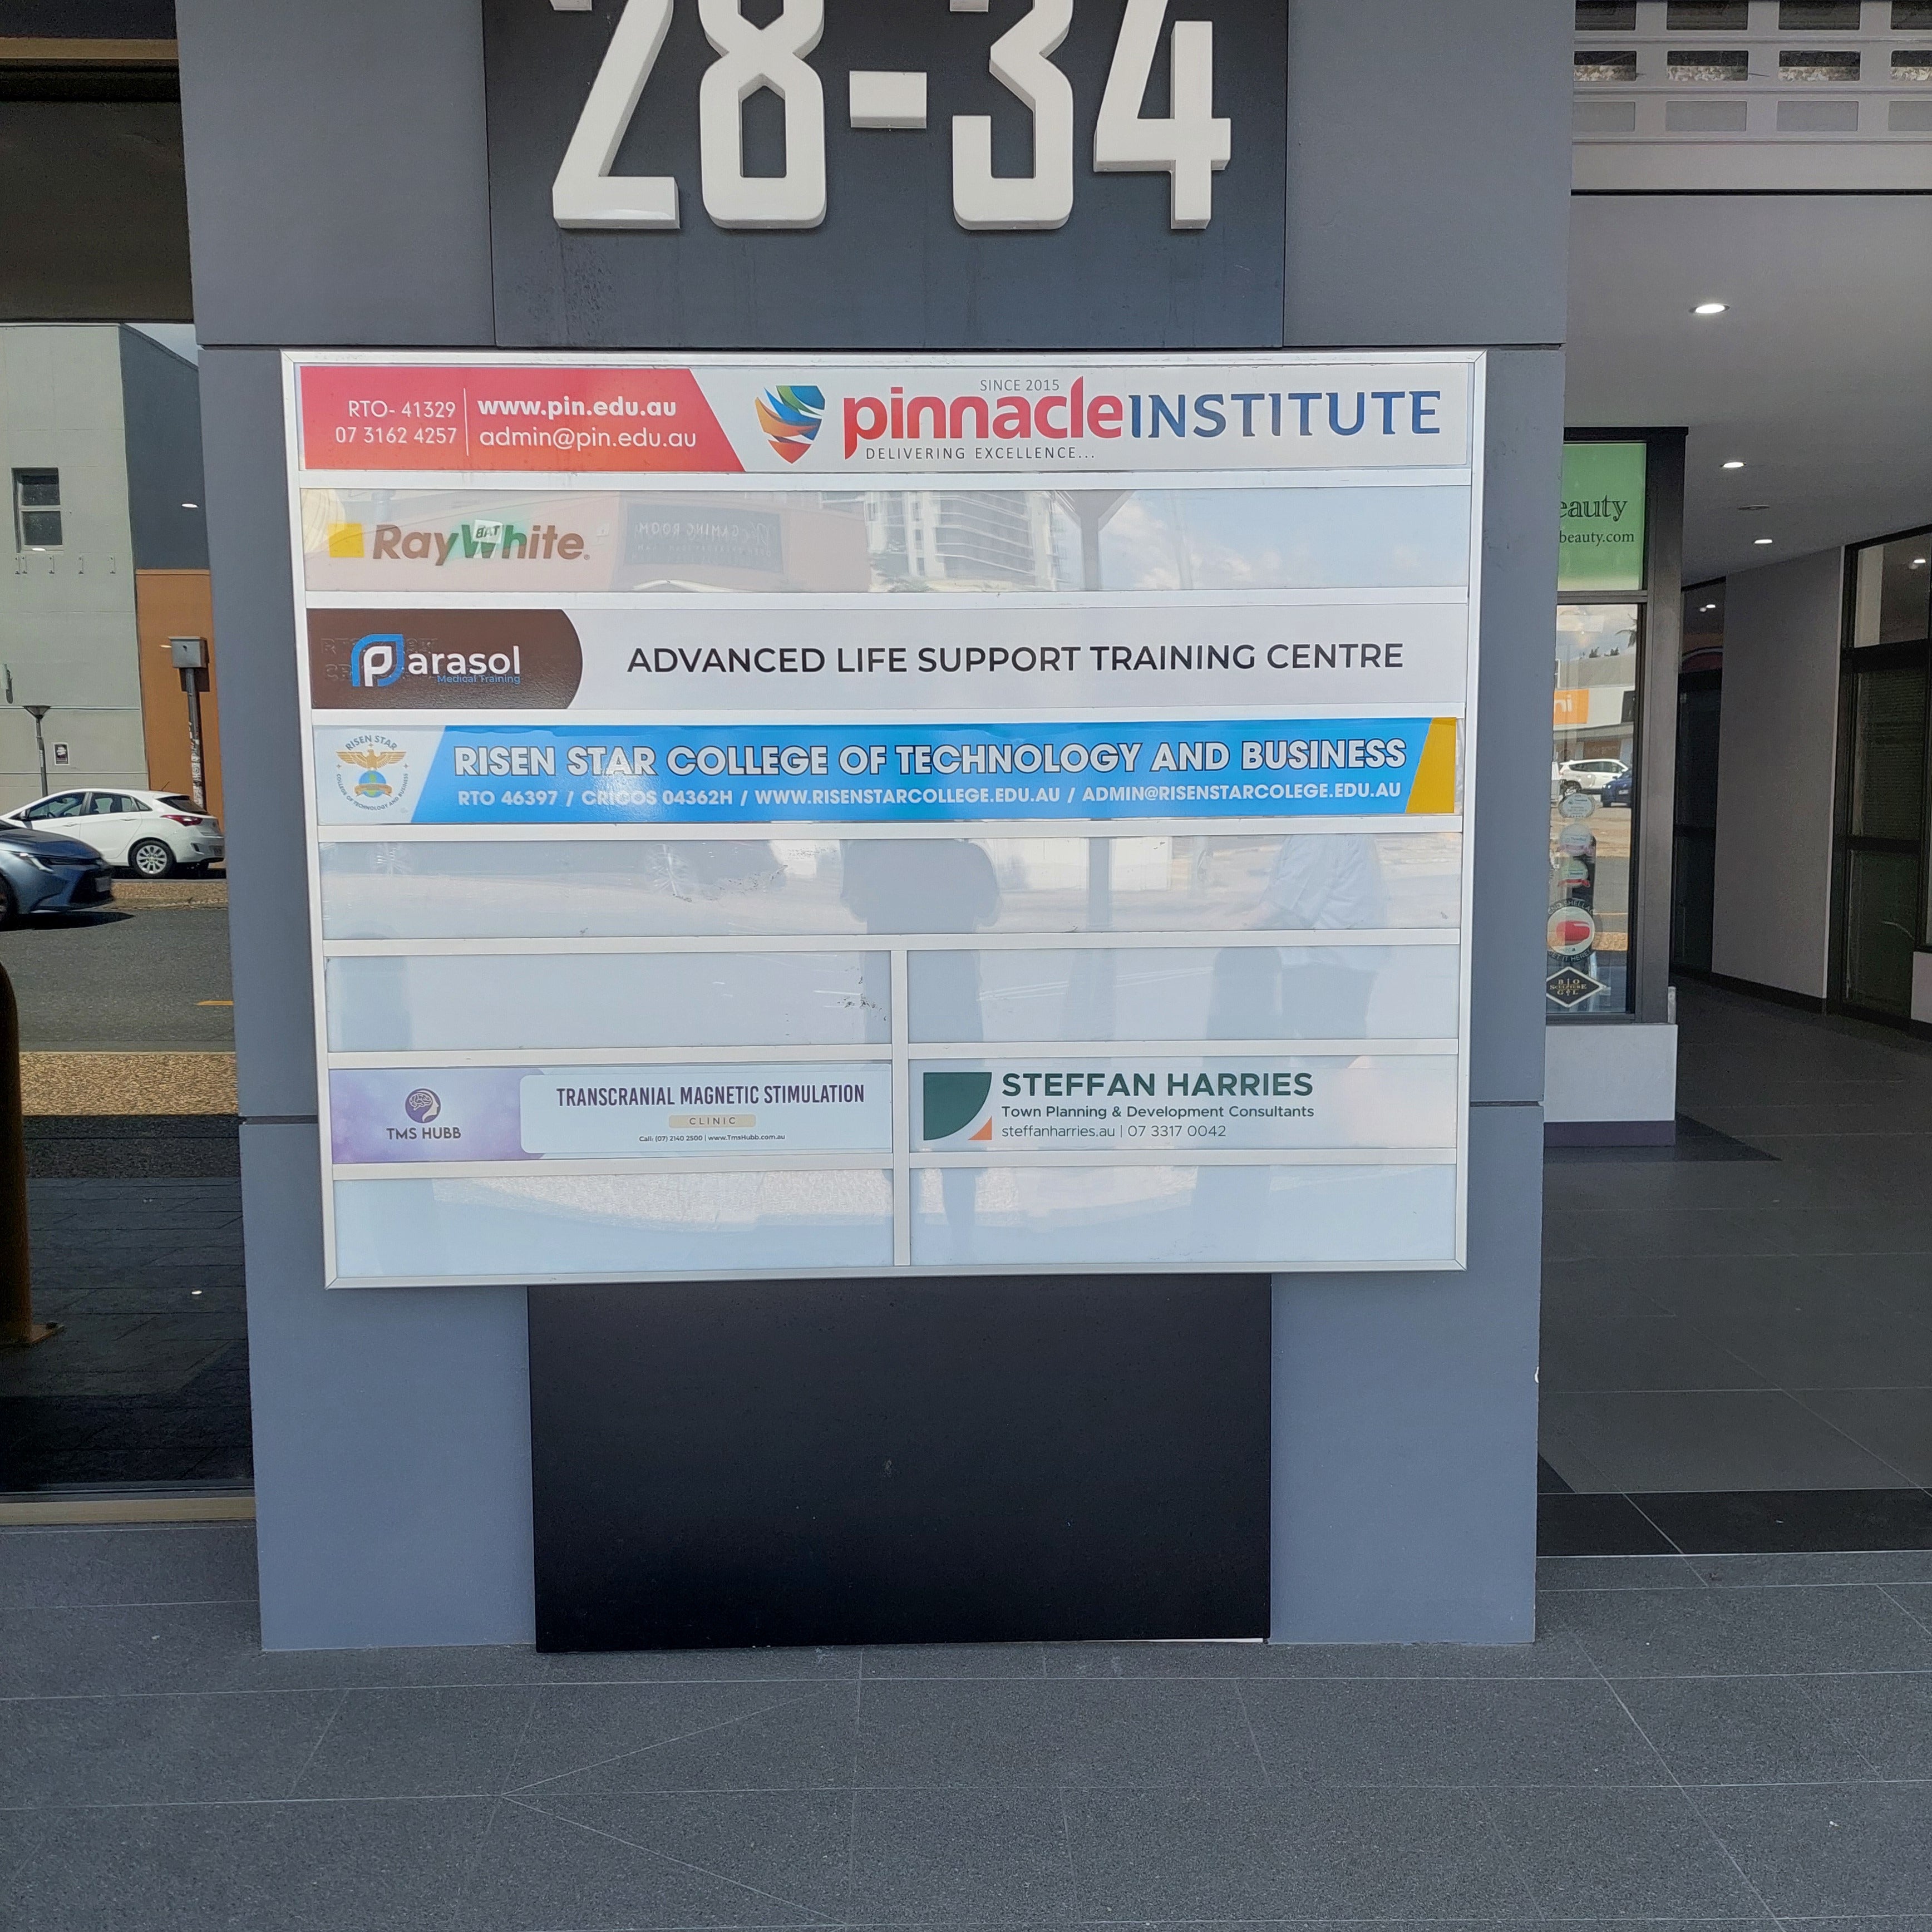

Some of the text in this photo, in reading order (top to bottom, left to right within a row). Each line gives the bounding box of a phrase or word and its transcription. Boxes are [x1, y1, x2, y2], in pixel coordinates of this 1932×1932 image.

[549, 0, 1230, 229] 28-34
[980, 379, 1060, 391] SINCE 2015
[348, 401, 456, 418] RTO- 41329
[477, 396, 677, 420] www.pin.edu.au
[335, 427, 457, 445] 07 3162 4257
[479, 427, 697, 451] admin@pin.edu.au
[865, 446, 1095, 460] DELIVERING EXCELLENCE...
[1560, 495, 1628, 522] eauty
[1559, 530, 1635, 546] beauty.com
[627, 643, 1404, 673] ADVANCED LIFE SUPPORT TRAINING CENTRE
[437, 675, 521, 685] Medical Training
[345, 735, 397, 751] RISEN STAR
[454, 738, 1407, 776] RISEN STAR COLLEGE OF TECHNOLOGY AND BUSINESS
[458, 790, 495, 806] RTO
[501, 790, 558, 806] 46397
[581, 790, 658, 806] CRICOS
[662, 790, 733, 806] 04362H
[755, 787, 1060, 805] WWW.RISENSTARCOLLEGE.EDU.AU
[1082, 782, 1401, 802] ADMIN@RISENSTARCOLEGE.EDU.AU
[1002, 1072, 1314, 1097] STEFFAN HARRIES
[556, 1085, 865, 1107] TRANSCRANIAL MAGNETIC STIMULATION
[689, 1117, 736, 1125] CLINIC
[1002, 1104, 1314, 1121] Town Planning & Development Consultants
[386, 1126, 462, 1140] TMS HUBB
[1002, 1124, 1116, 1138] steffanharries.au
[1127, 1125, 1147, 1138] 07
[1150, 1125, 1182, 1137] 3317
[1187, 1124, 1227, 1137] 0042
